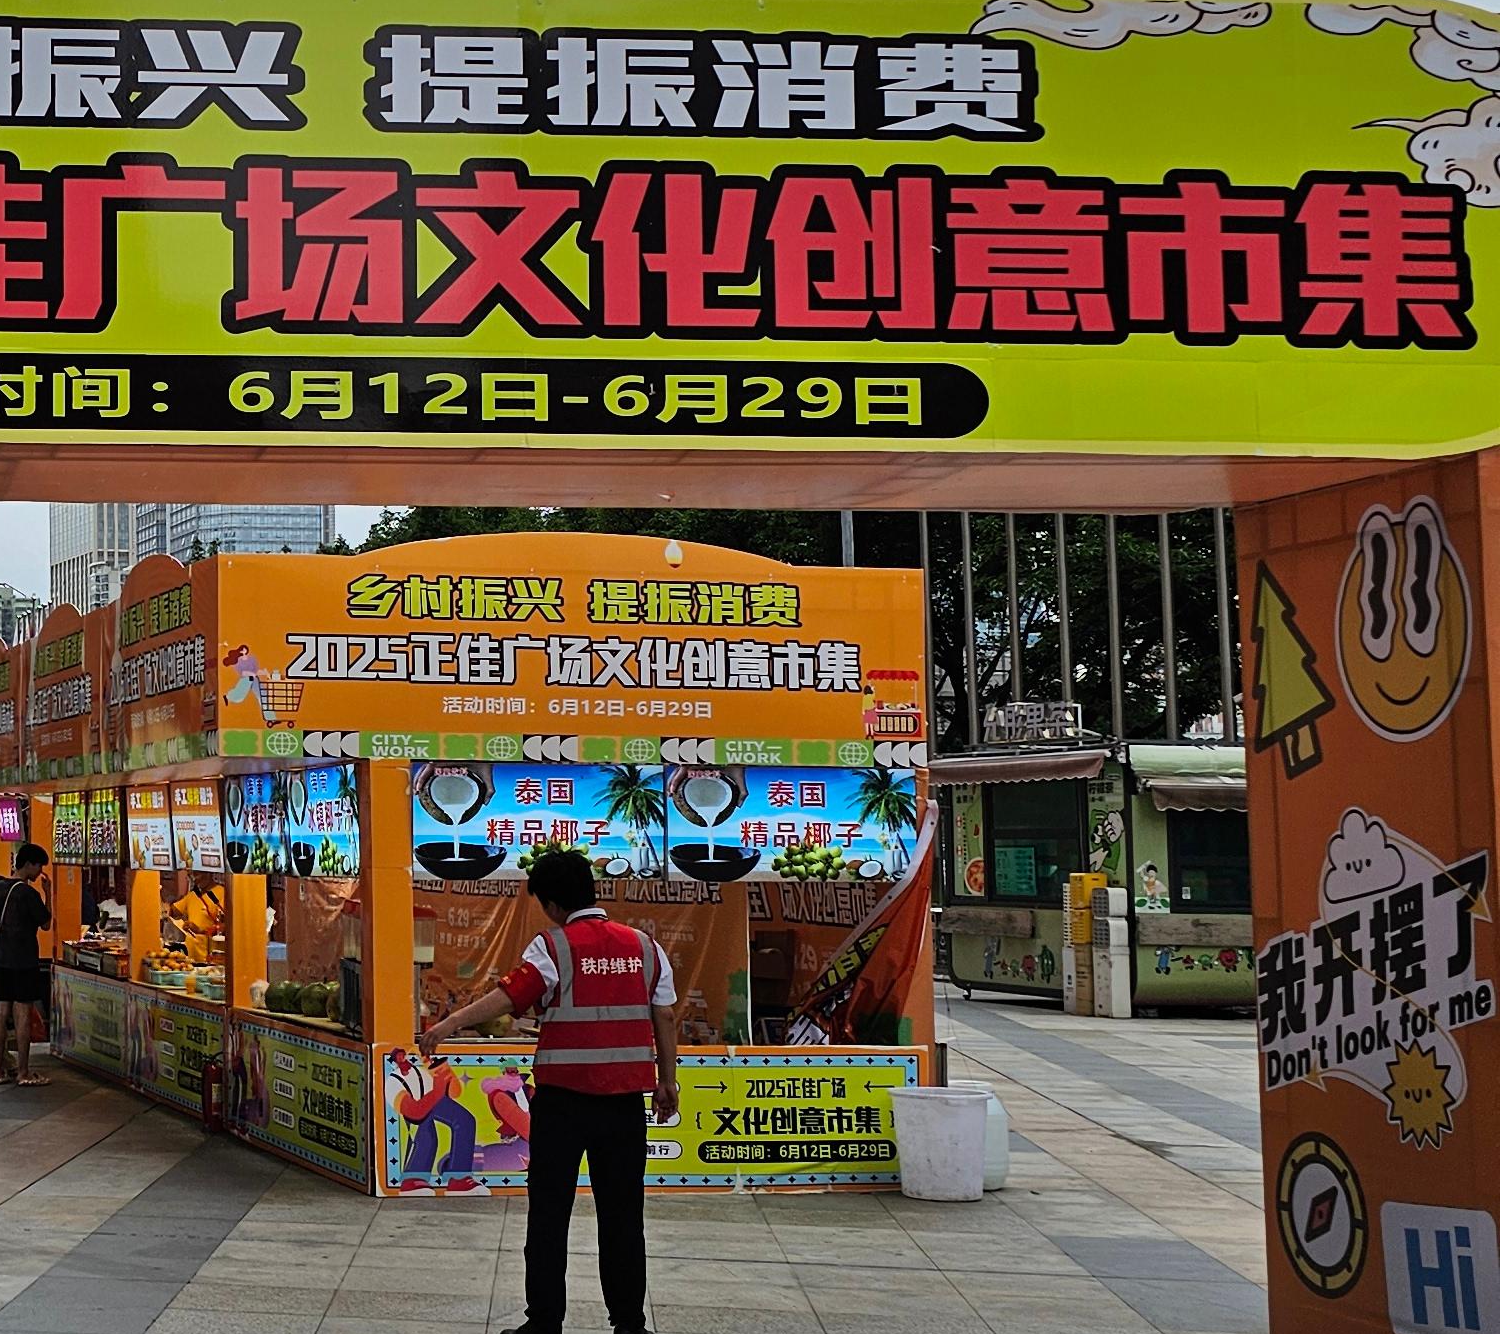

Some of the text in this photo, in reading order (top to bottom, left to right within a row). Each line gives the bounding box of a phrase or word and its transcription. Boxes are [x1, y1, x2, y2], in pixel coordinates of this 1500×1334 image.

[370, 28, 1040, 138] 提振消费
[347, 574, 802, 627] 乡村振兴 提振消费
[286, 633, 861, 692] 2025正佳广场文化创意市集
[371, 746, 429, 758] WORK
[725, 752, 782, 764] WORK
[514, 777, 574, 805] 泰国
[767, 780, 826, 808] 泰国
[486, 818, 610, 846] 精品椰子
[740, 821, 863, 848] 精品椰子
[1258, 855, 1487, 1047] 我开摆了
[581, 957, 643, 975] 秩序维护
[1266, 983, 1492, 1088] Don't look for me
[745, 1077, 847, 1099] 2025正佳广场
[712, 1106, 883, 1136] 文化创意市集
[1403, 1224, 1482, 1331] Hi
